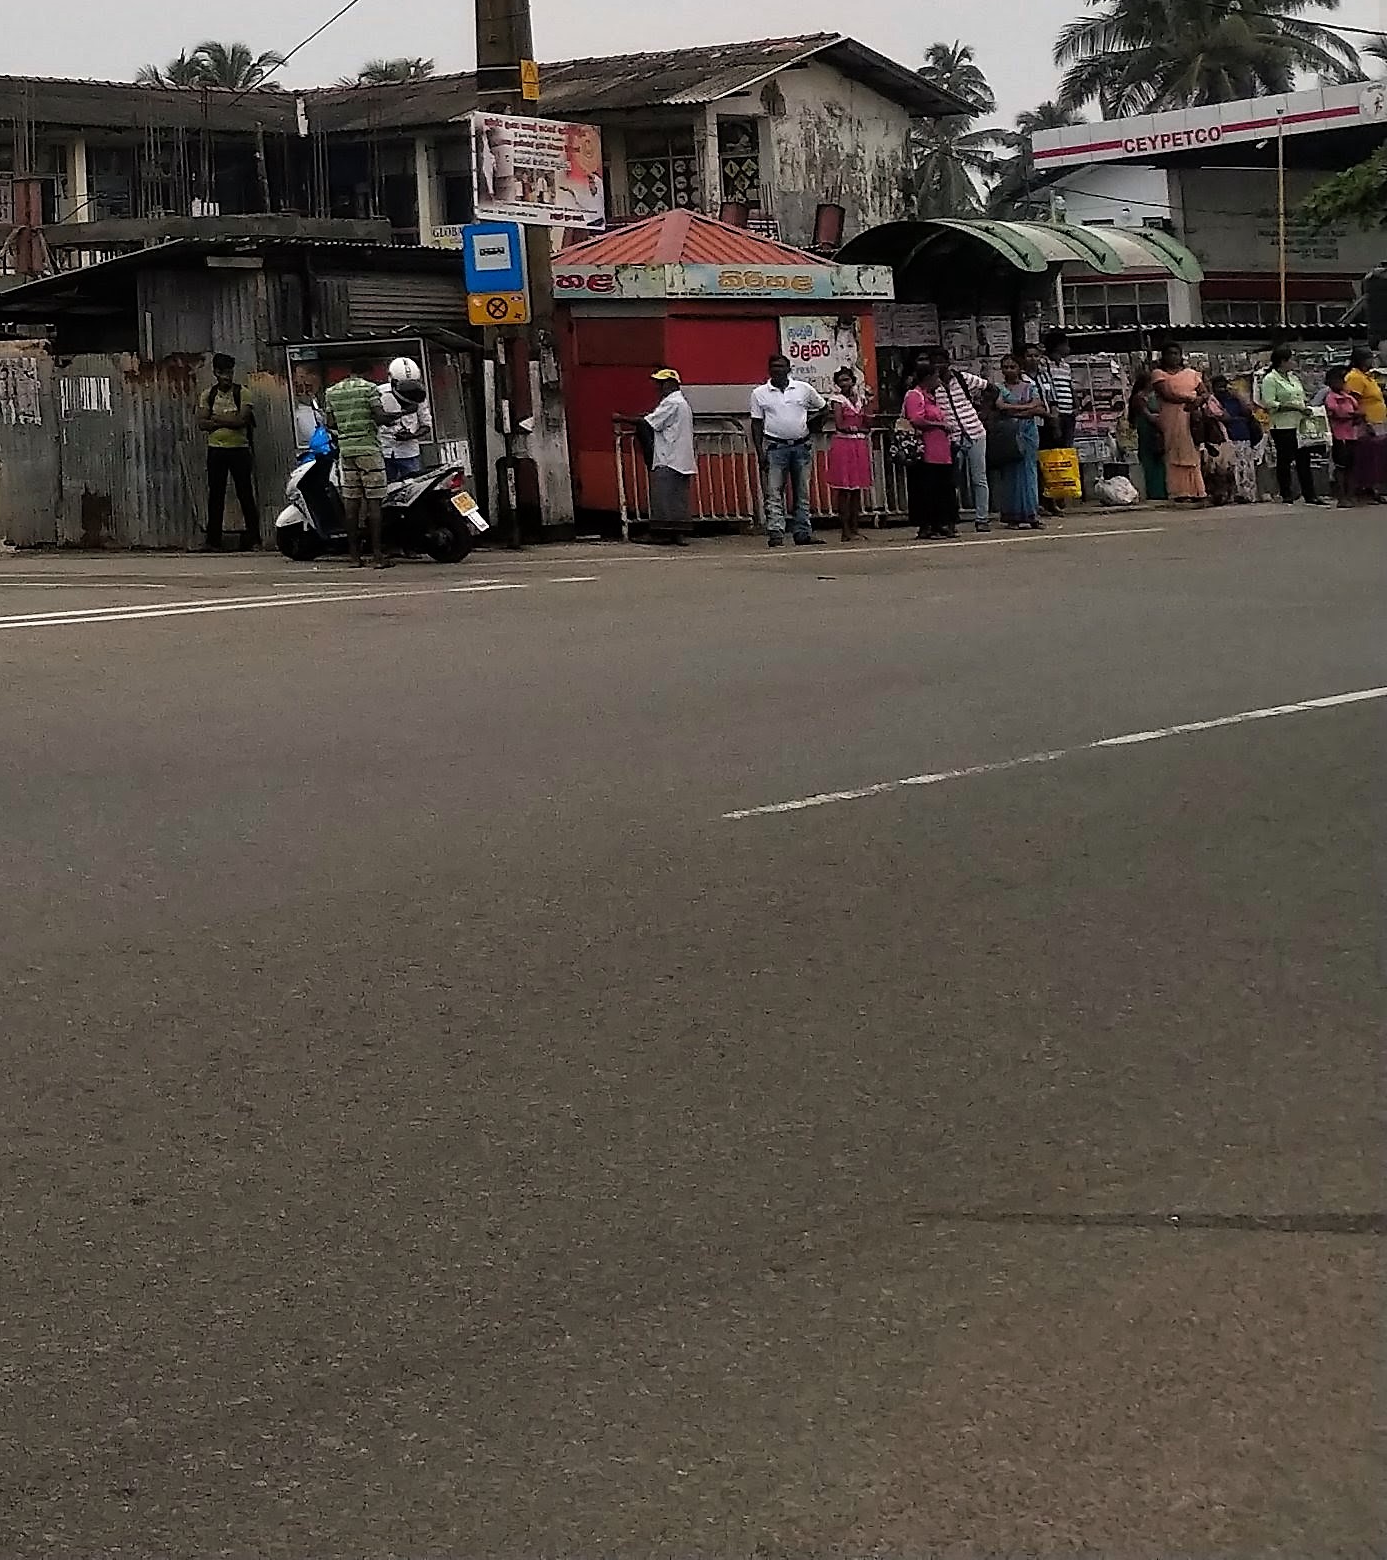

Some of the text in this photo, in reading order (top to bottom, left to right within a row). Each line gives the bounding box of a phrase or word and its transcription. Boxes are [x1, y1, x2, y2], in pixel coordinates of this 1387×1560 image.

[1124, 126, 1221, 153] CEYPETCO
[555, 273, 616, 293] හළ
[789, 339, 830, 362] එළකිරි
